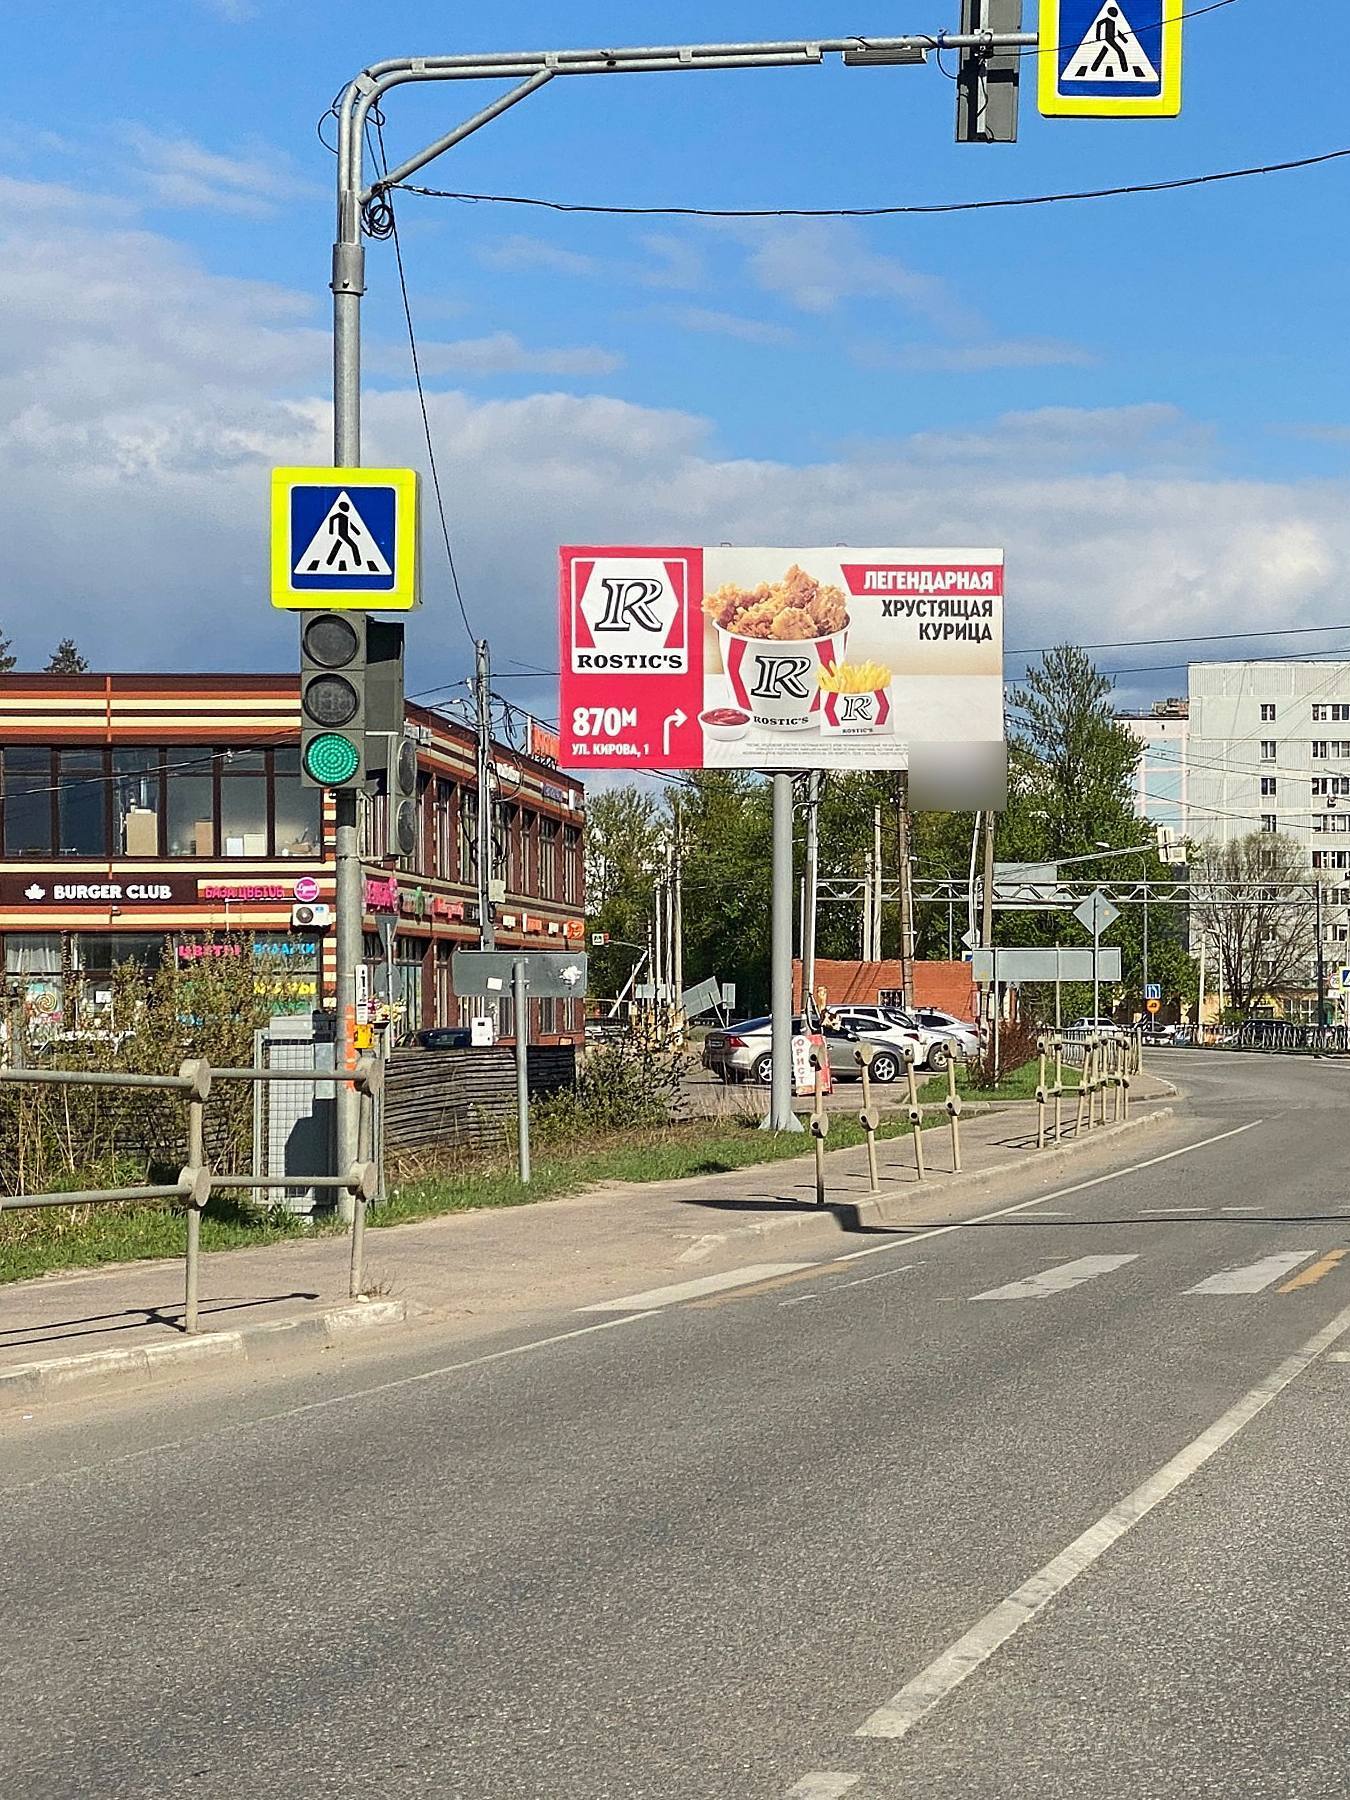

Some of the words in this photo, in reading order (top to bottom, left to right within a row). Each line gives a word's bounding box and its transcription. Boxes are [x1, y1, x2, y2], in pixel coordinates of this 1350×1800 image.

[864, 571, 994, 593] ЛЕГЕНДАРНАЯ
[881, 600, 993, 620] ХРУСТЯЩАЯ
[919, 623, 993, 643] КУРИЦА
[577, 654, 683, 669] ROSTIC'S
[753, 715, 809, 726] ROSTIC'S
[571, 743, 591, 756] УЛ.
[593, 743, 641, 758] КИРОВА,
[644, 743, 650, 755] 1
[53, 884, 123, 900] BURGER
[126, 884, 173, 900] CLUB
